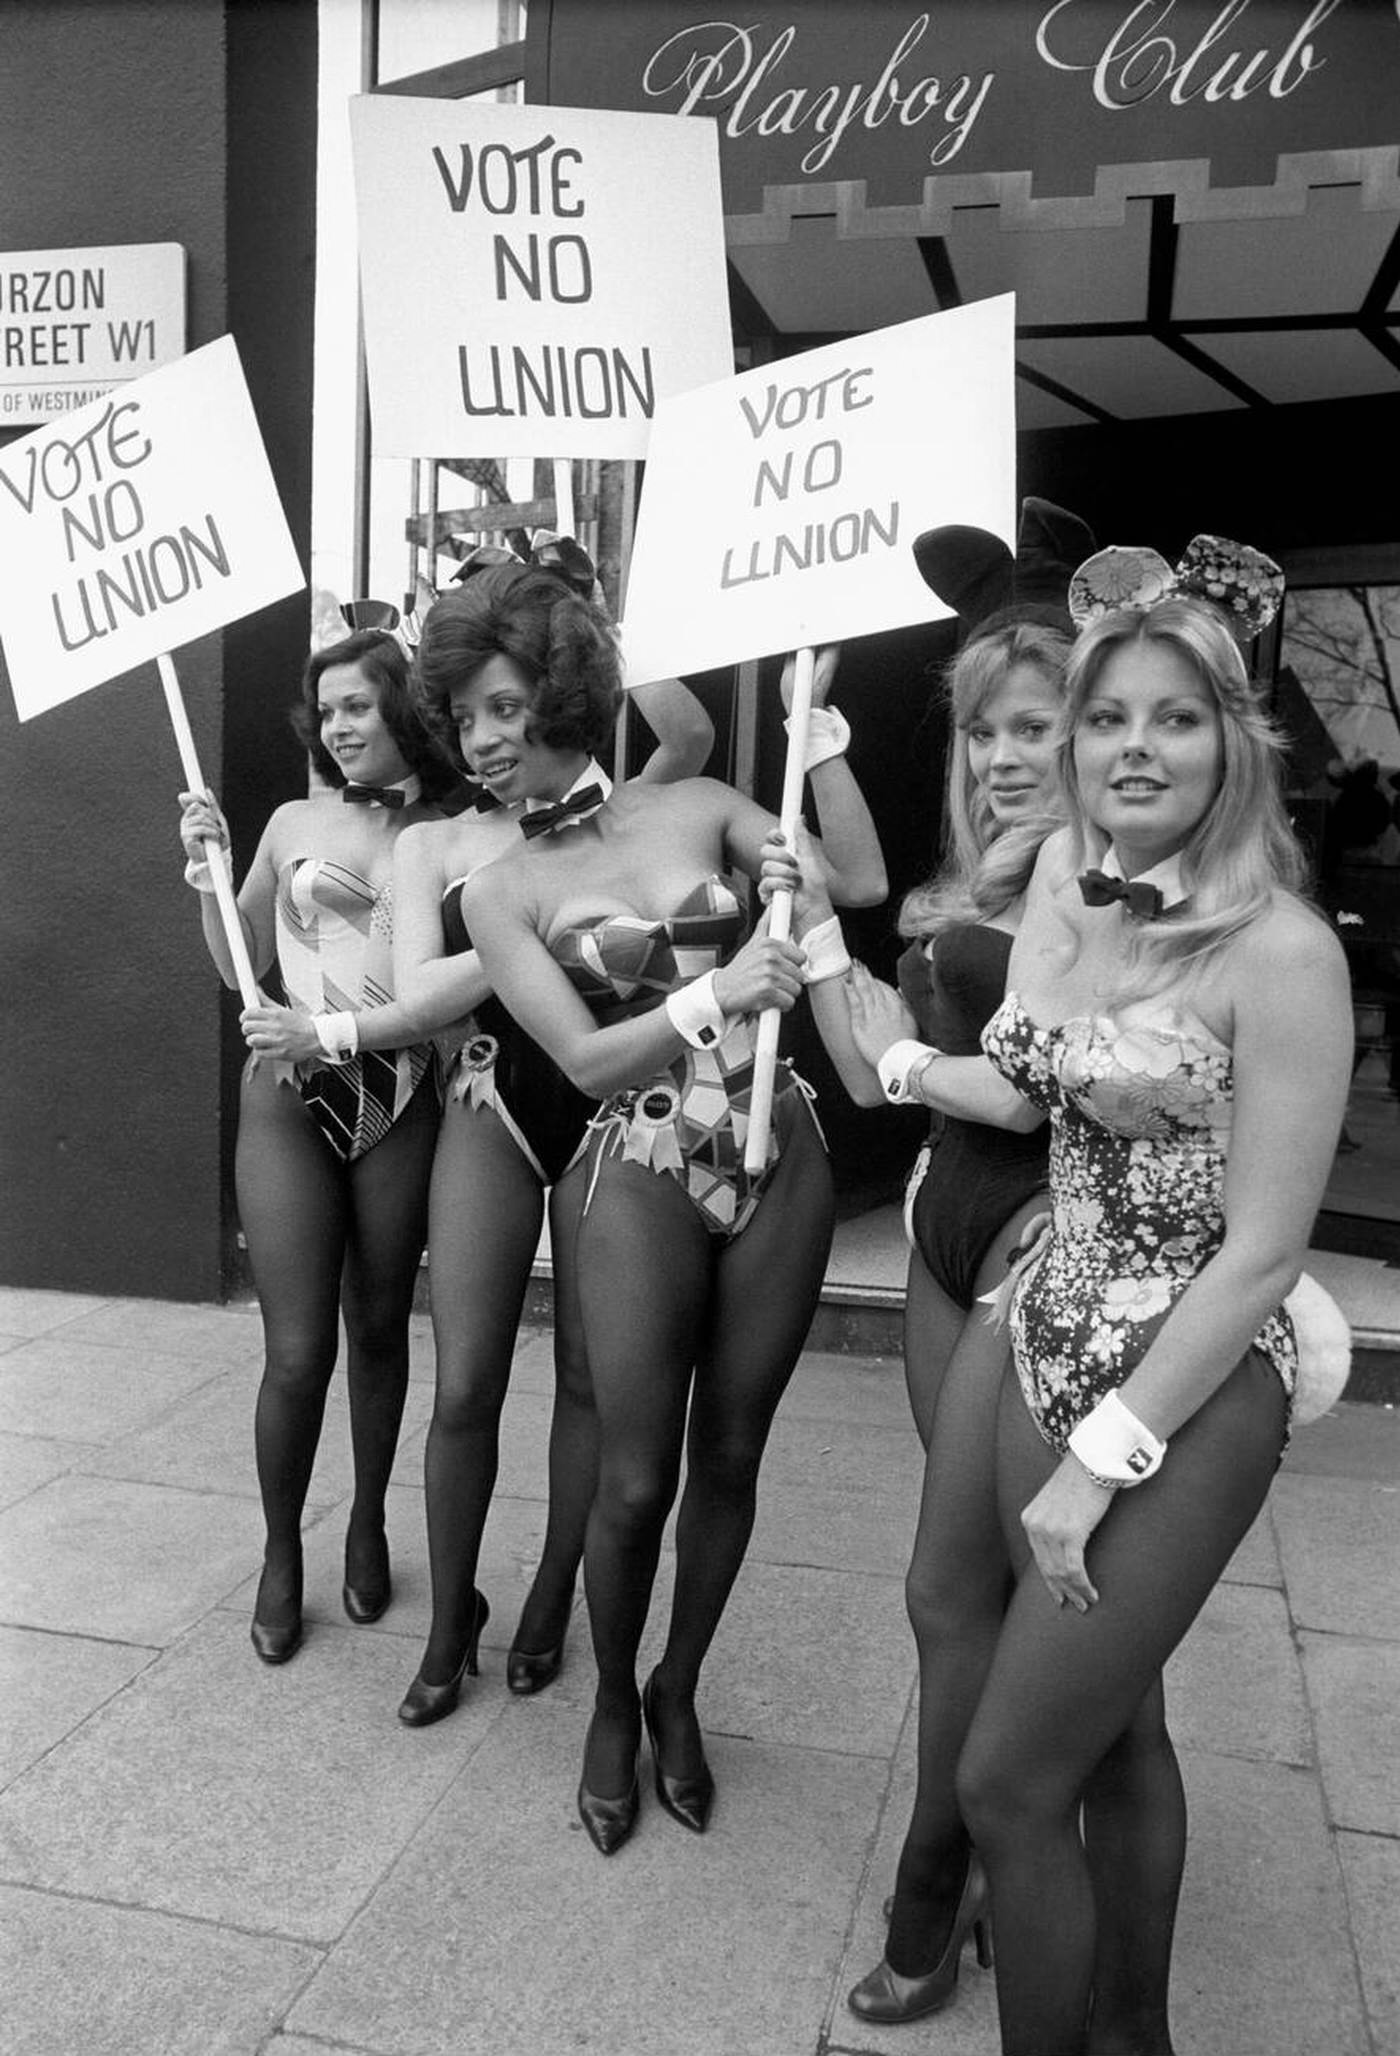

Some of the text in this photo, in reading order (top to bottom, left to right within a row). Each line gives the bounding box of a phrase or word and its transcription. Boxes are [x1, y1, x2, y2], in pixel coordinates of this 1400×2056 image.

[642, 0, 1327, 173] Playboy Club
[431, 134, 585, 218] VOTE
[0, 268, 104, 313] RZON
[493, 233, 593, 304] NO
[0, 318, 155, 367] REET W1
[3, 389, 113, 413] OF WESTMI
[458, 345, 655, 419] UNION
[739, 367, 874, 439] VOTE
[0, 401, 152, 514] VOTE
[753, 439, 842, 507] NO
[62, 479, 144, 562] NO
[720, 501, 899, 590] UNION
[51, 513, 231, 652] UNION
